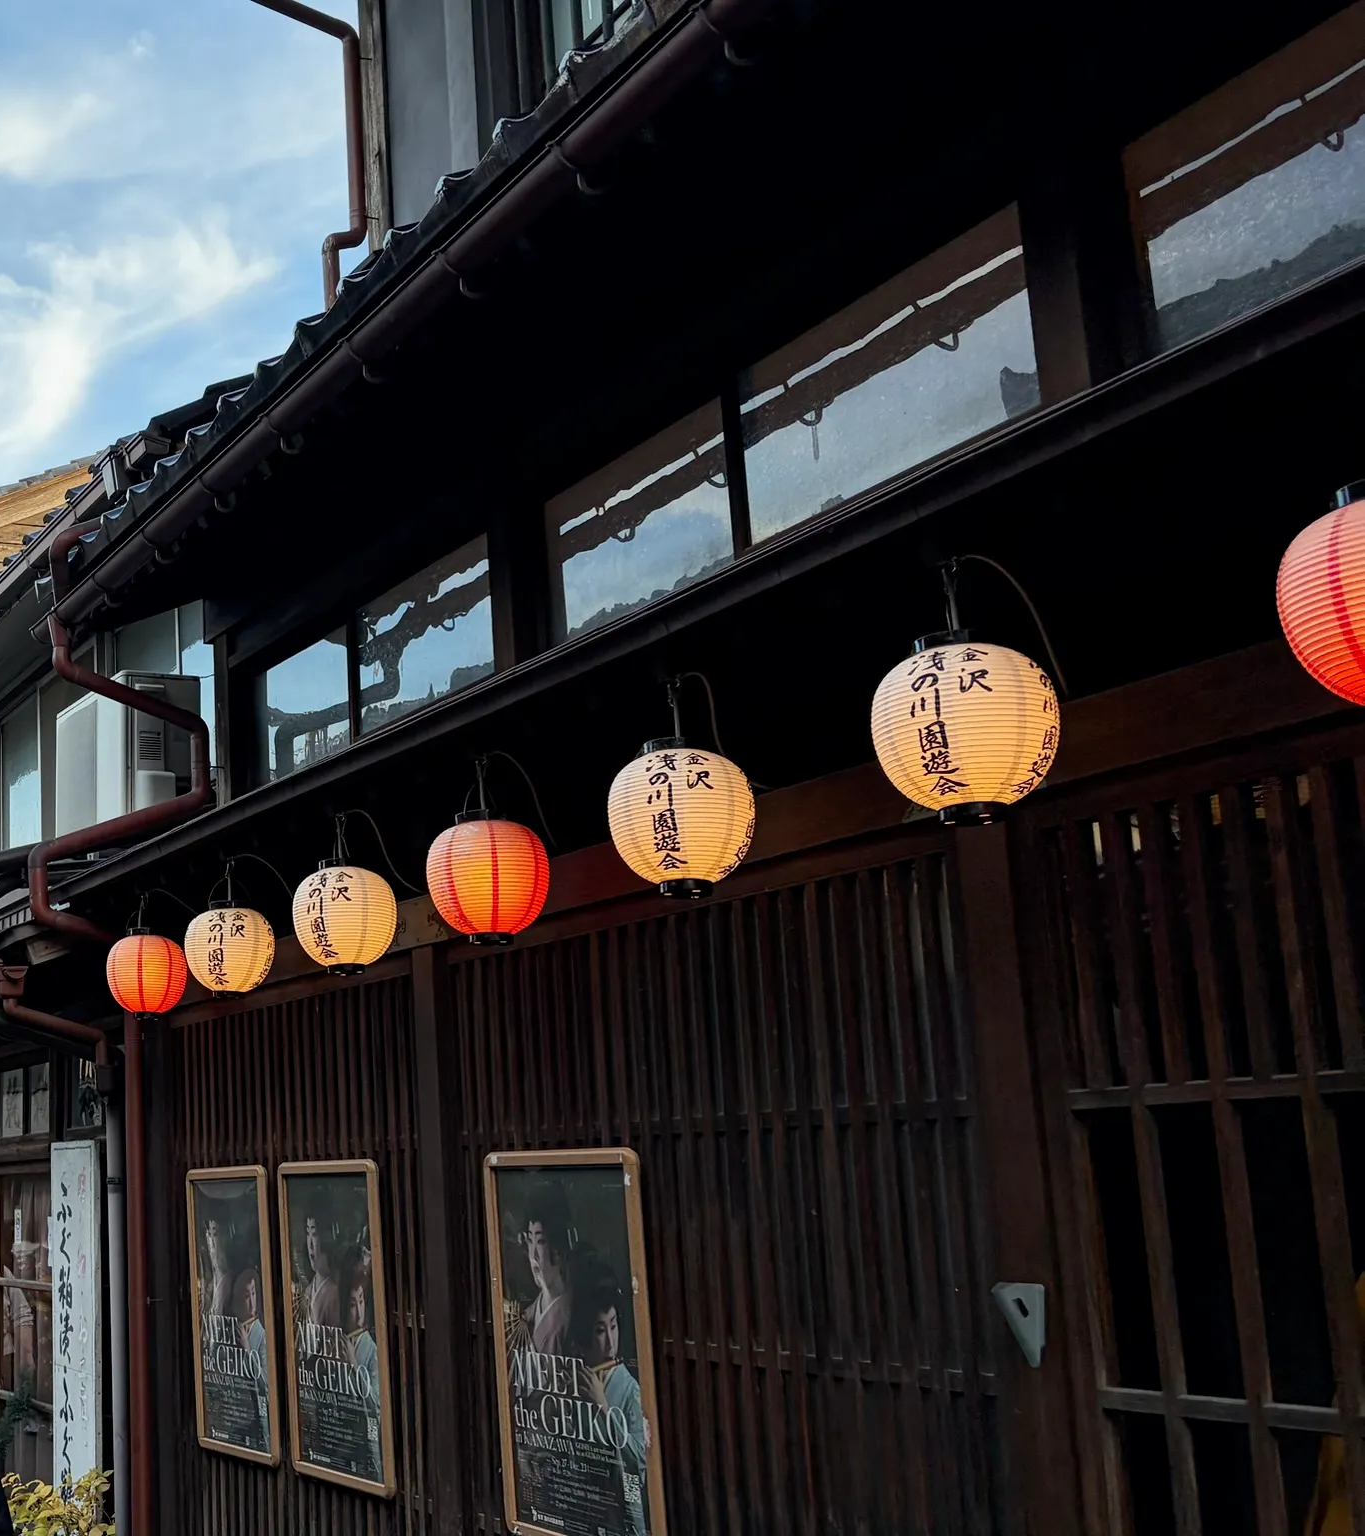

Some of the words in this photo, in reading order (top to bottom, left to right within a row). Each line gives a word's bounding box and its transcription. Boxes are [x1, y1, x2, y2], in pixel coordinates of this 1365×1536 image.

[953, 647, 993, 692] 金沢
[907, 651, 970, 796] 浅の川園遊会
[682, 752, 714, 790] 金沢
[645, 752, 688, 871] 浅の川園遊会
[329, 870, 354, 902] 金沢
[228, 909, 248, 938] 金沢
[202, 1314, 238, 1345] MEET
[296, 1321, 343, 1359] MEET
[216, 1344, 262, 1379] GEIKO
[298, 1361, 315, 1387] the
[315, 1357, 371, 1399] GEIKO
[512, 1348, 585, 1398] MEET
[514, 1398, 538, 1430] the
[540, 1394, 629, 1450] GEIKO
[523, 1431, 576, 1456] KANAZAWA
